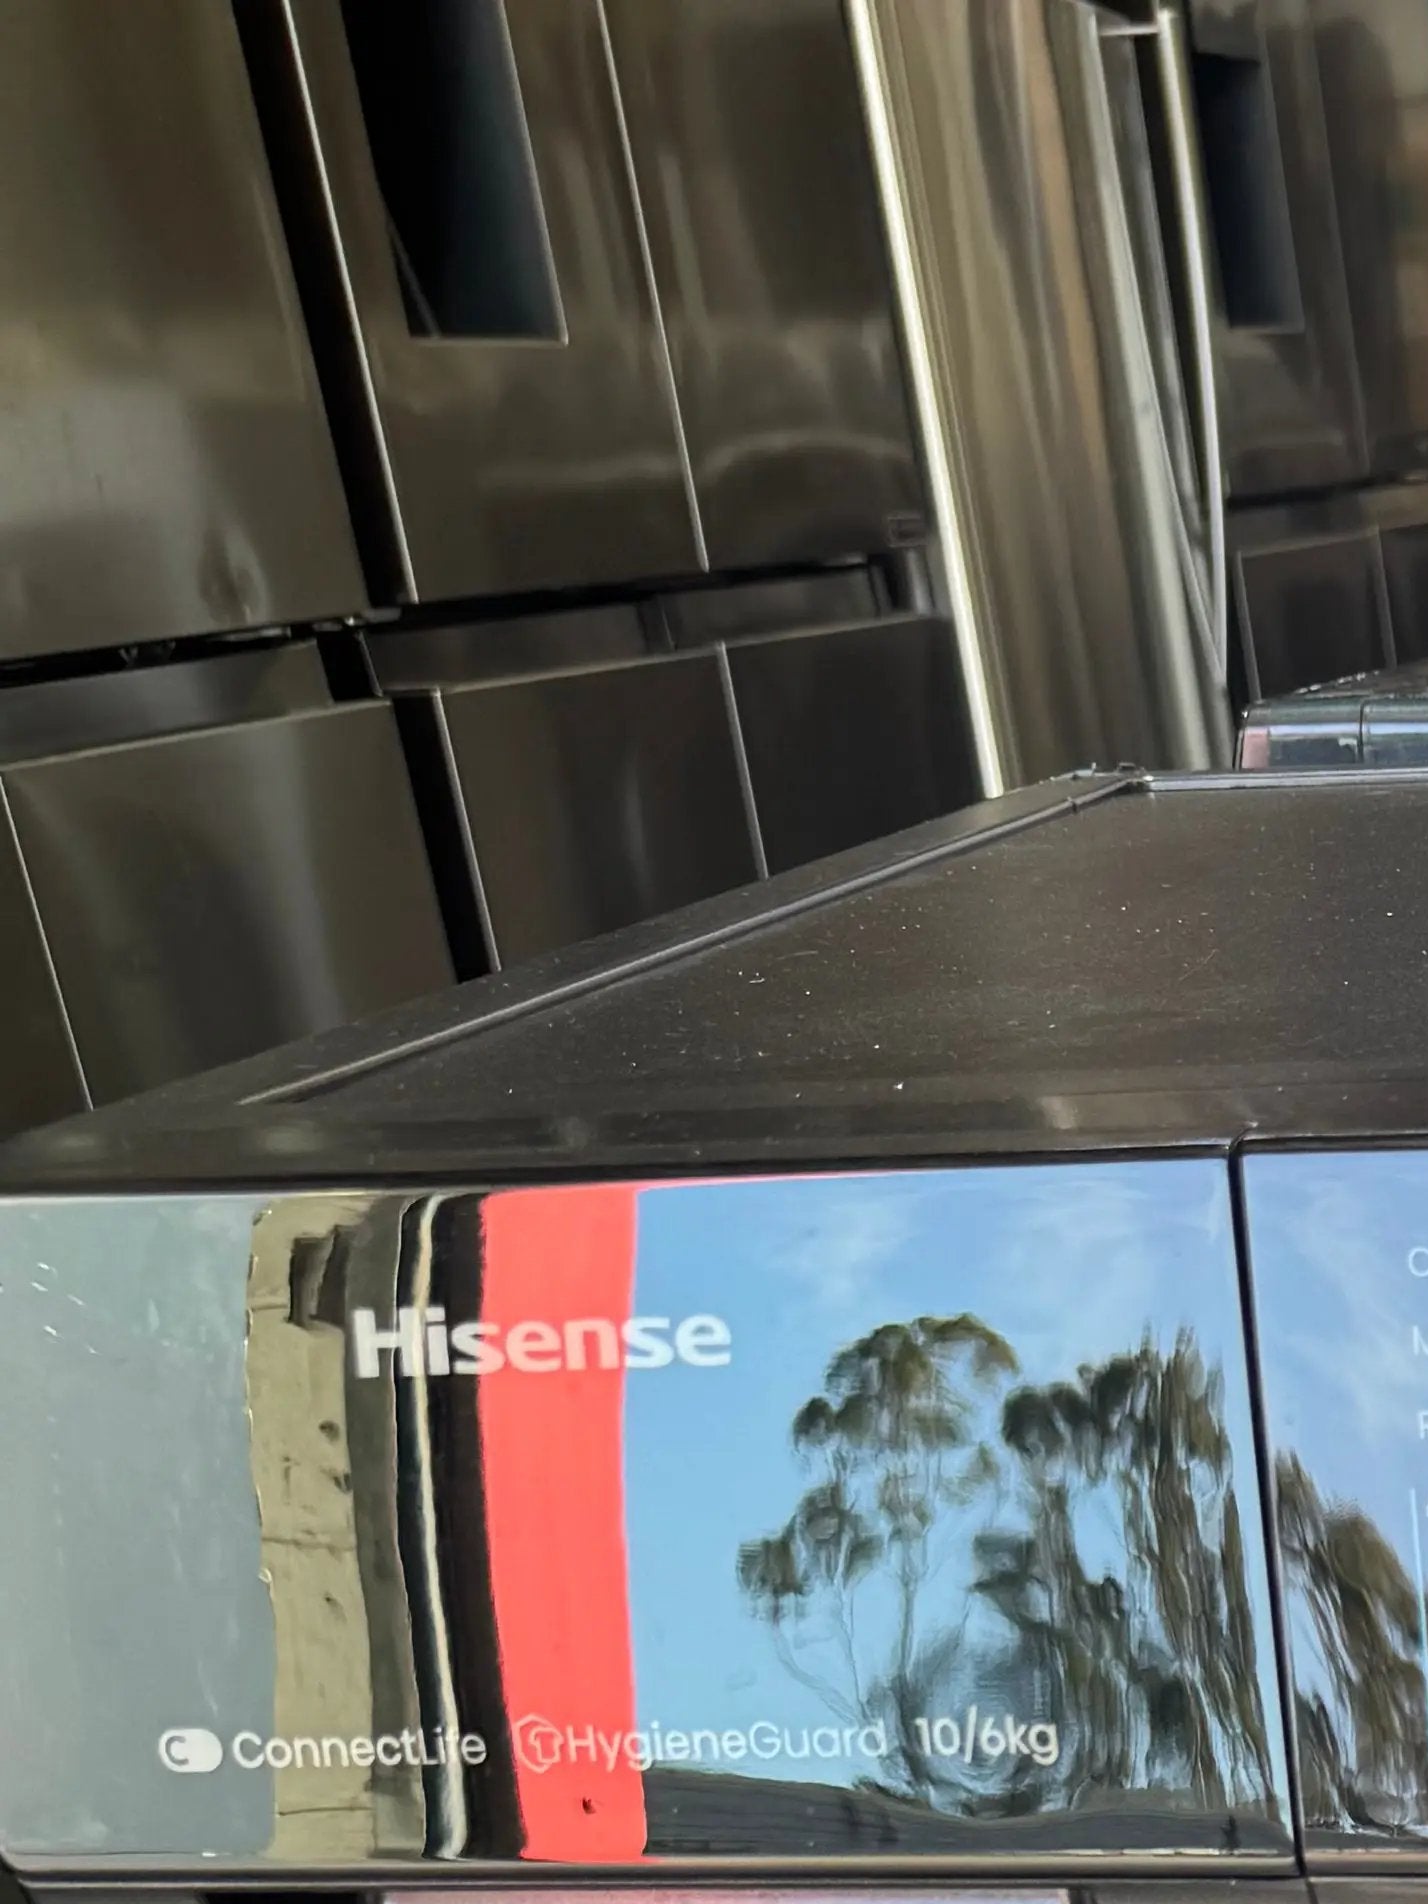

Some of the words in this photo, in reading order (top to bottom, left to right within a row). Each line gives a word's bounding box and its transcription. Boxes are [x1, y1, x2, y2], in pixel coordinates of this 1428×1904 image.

[351, 1305, 732, 1379] Hisense
[231, 1724, 488, 1770] ConnectLife
[567, 1718, 888, 1772] HygieneGuard
[915, 1704, 1060, 1767] 10/6kg
